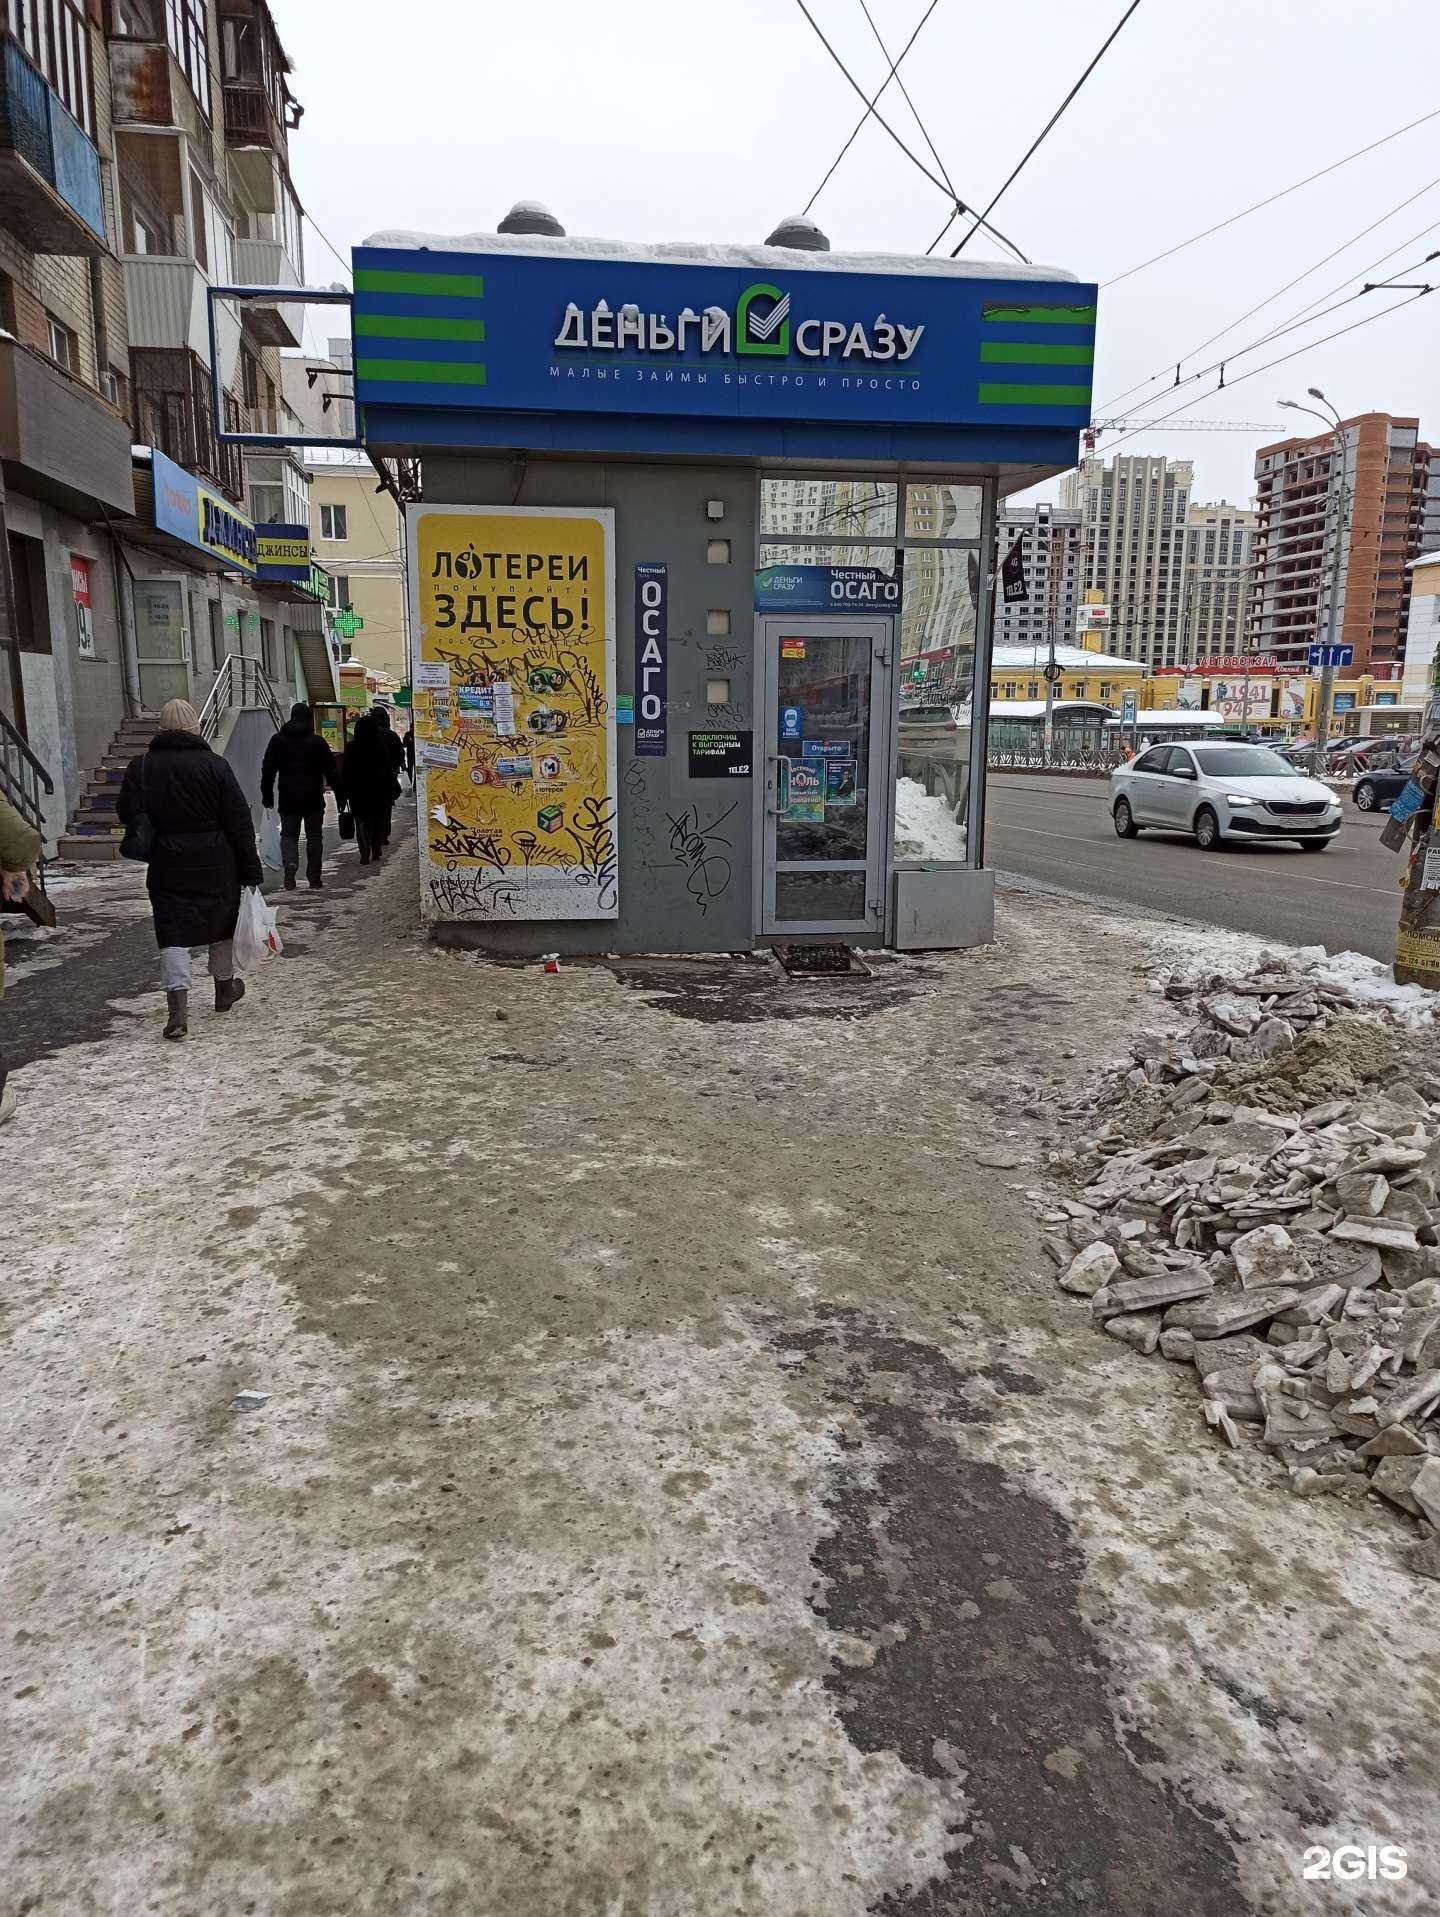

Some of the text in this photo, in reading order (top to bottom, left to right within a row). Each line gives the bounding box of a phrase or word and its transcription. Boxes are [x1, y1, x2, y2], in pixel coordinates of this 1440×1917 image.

[554, 309, 925, 360] ДЕНЬГИ СРАЗУ
[550, 366, 920, 390] МАЛЫЕ ЗАЙМЫ БЫСТРО И ПРОСТО
[256, 543, 308, 558] ДЖИНСЫ
[432, 548, 588, 581] ЛОТЕРЕИ
[773, 576, 803, 584] ДЕНЬГИ
[830, 570, 876, 580] Честный
[434, 584, 588, 595] ПОКУПАЙТЕ
[773, 583, 796, 591] СРАЗУ
[830, 580, 899, 600] ОСАГО
[1005, 581, 1024, 597] TELE2
[434, 594, 589, 634] ЗДЕСЬ!
[641, 581, 663, 720] ОСАГО
[1199, 656, 1278, 668] АВТОВОКЗАЛ
[459, 686, 492, 695] КРЕДИТ
[1230, 685, 1267, 700] 1941
[698, 741, 741, 749] ВЫГОДНЫМ
[728, 764, 750, 774] TELE2
